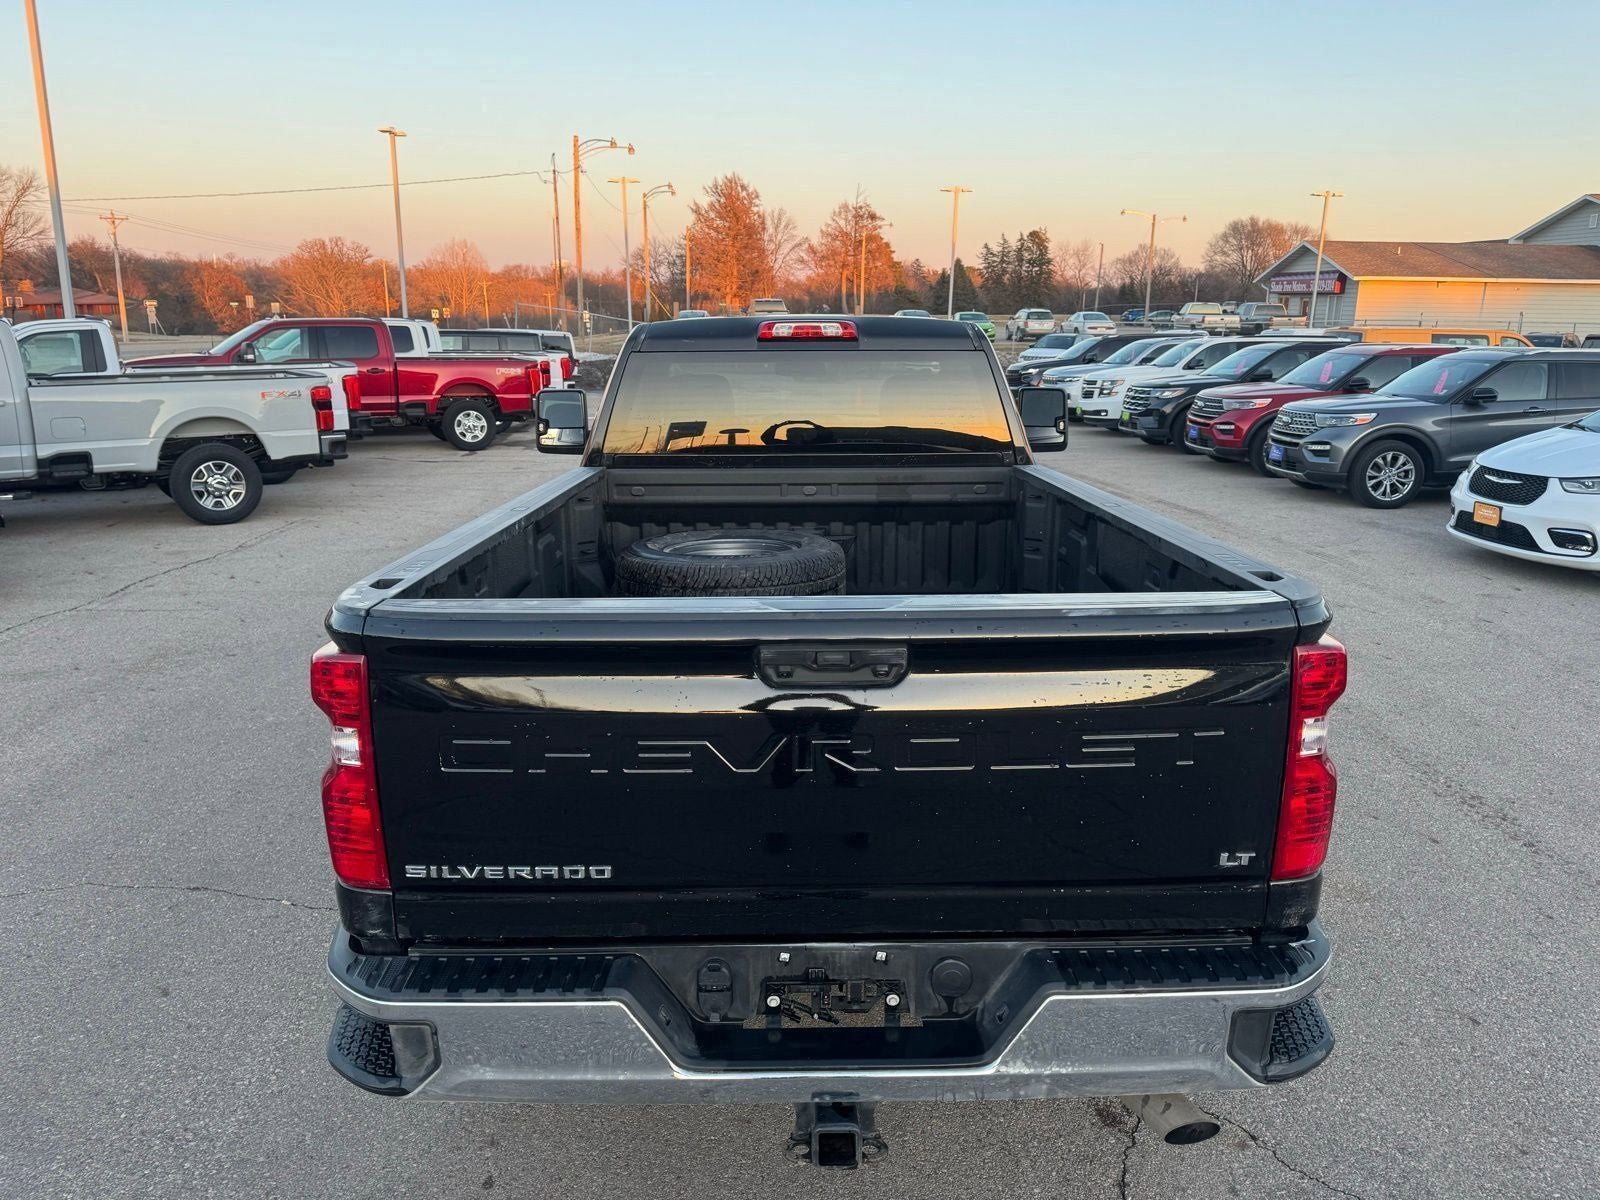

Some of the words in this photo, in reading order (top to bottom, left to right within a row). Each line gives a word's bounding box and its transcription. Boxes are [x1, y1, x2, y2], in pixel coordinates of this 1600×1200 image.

[260, 390, 302, 400] FX4
[439, 731, 1225, 773] CHEVROLET
[1218, 852, 1256, 868] LT
[405, 864, 613, 880] SILVERADO
